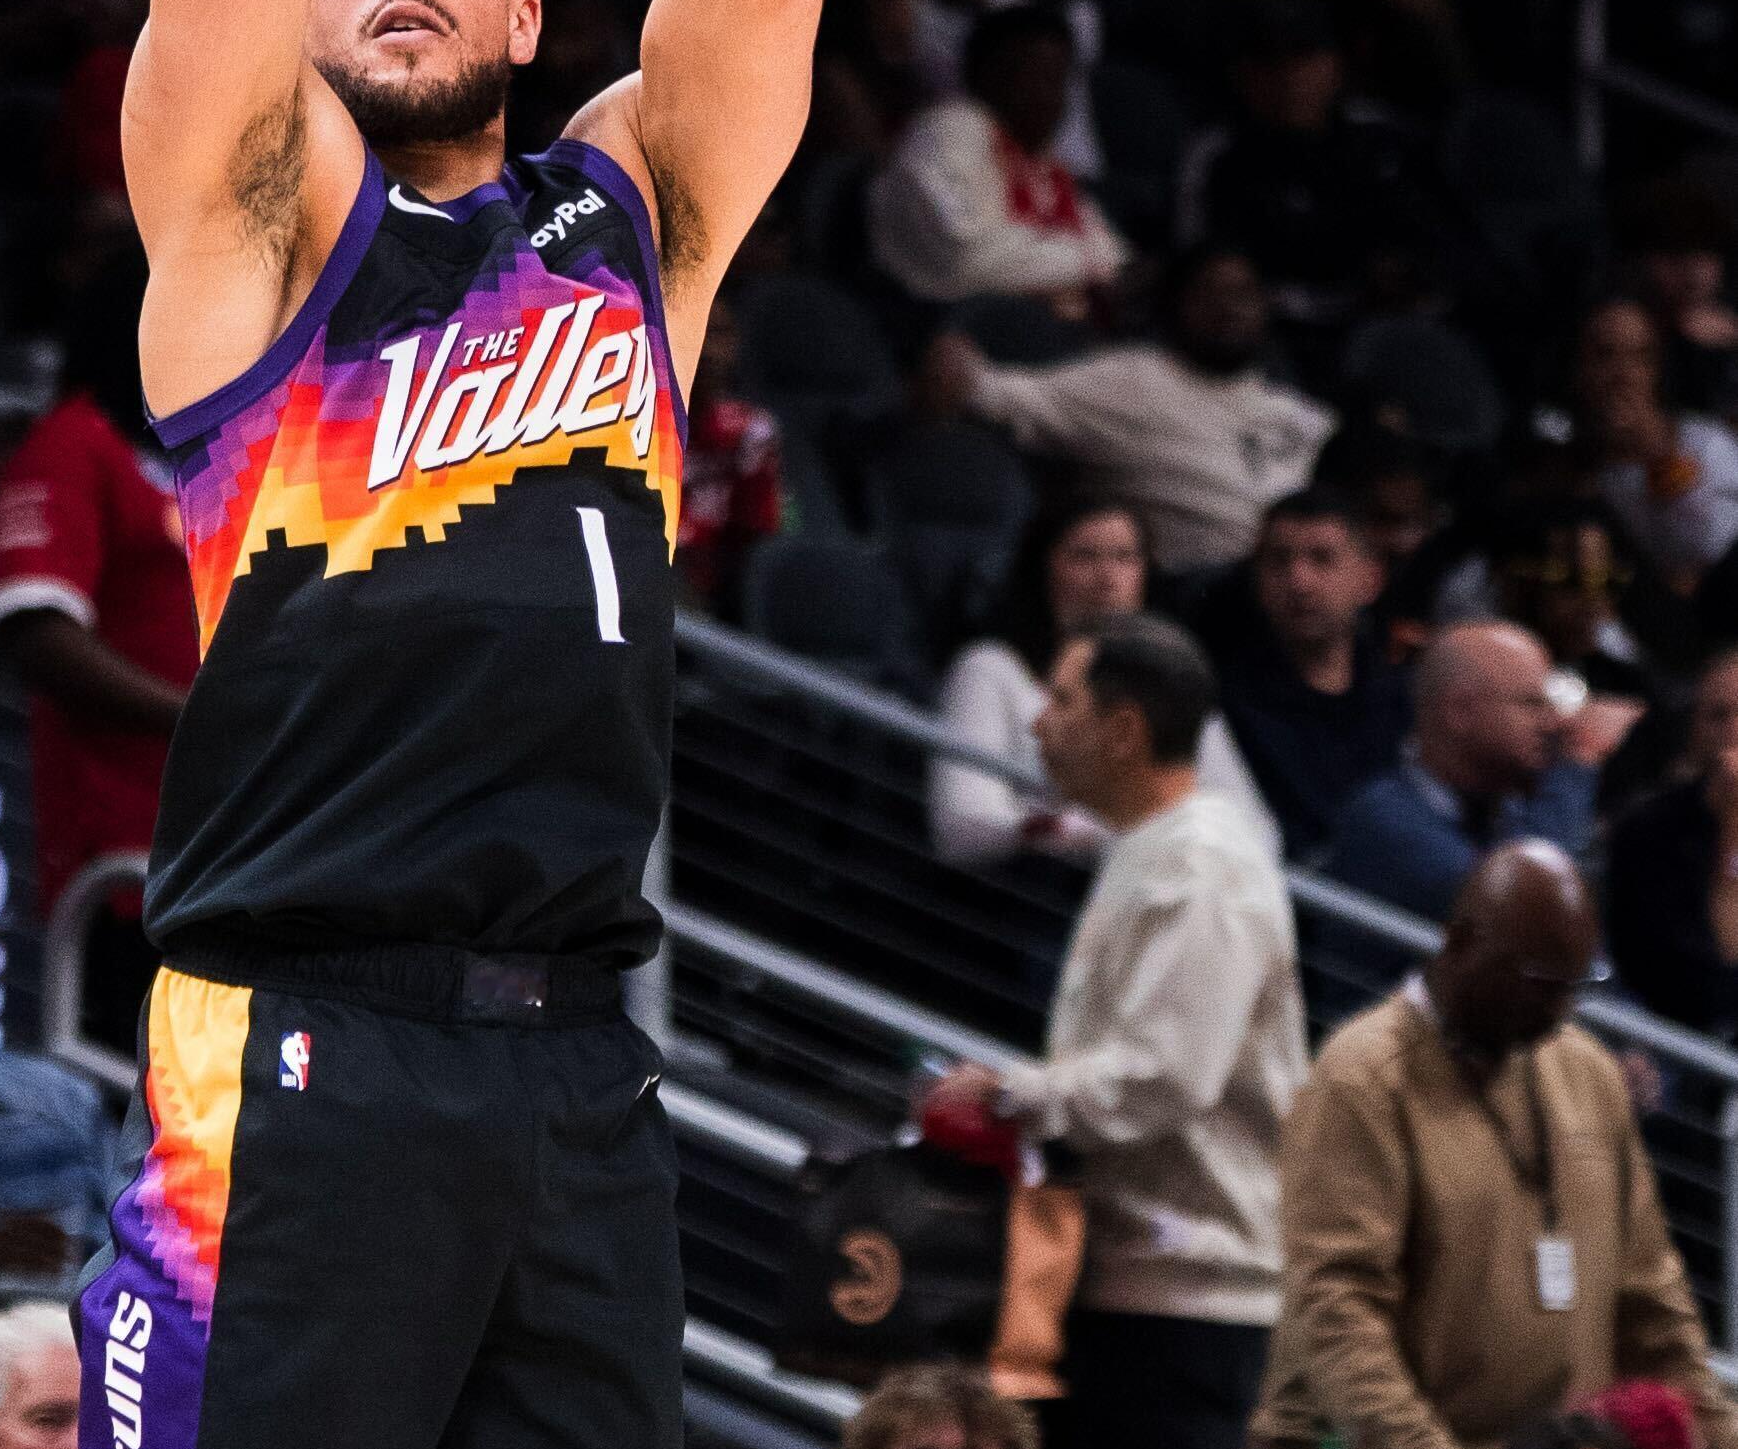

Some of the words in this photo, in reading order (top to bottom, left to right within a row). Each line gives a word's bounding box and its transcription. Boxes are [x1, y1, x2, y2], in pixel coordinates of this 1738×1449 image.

[530, 188, 607, 248] ayPal
[367, 293, 657, 492] Valley
[463, 326, 524, 367] THE
[576, 506, 624, 644] 1
